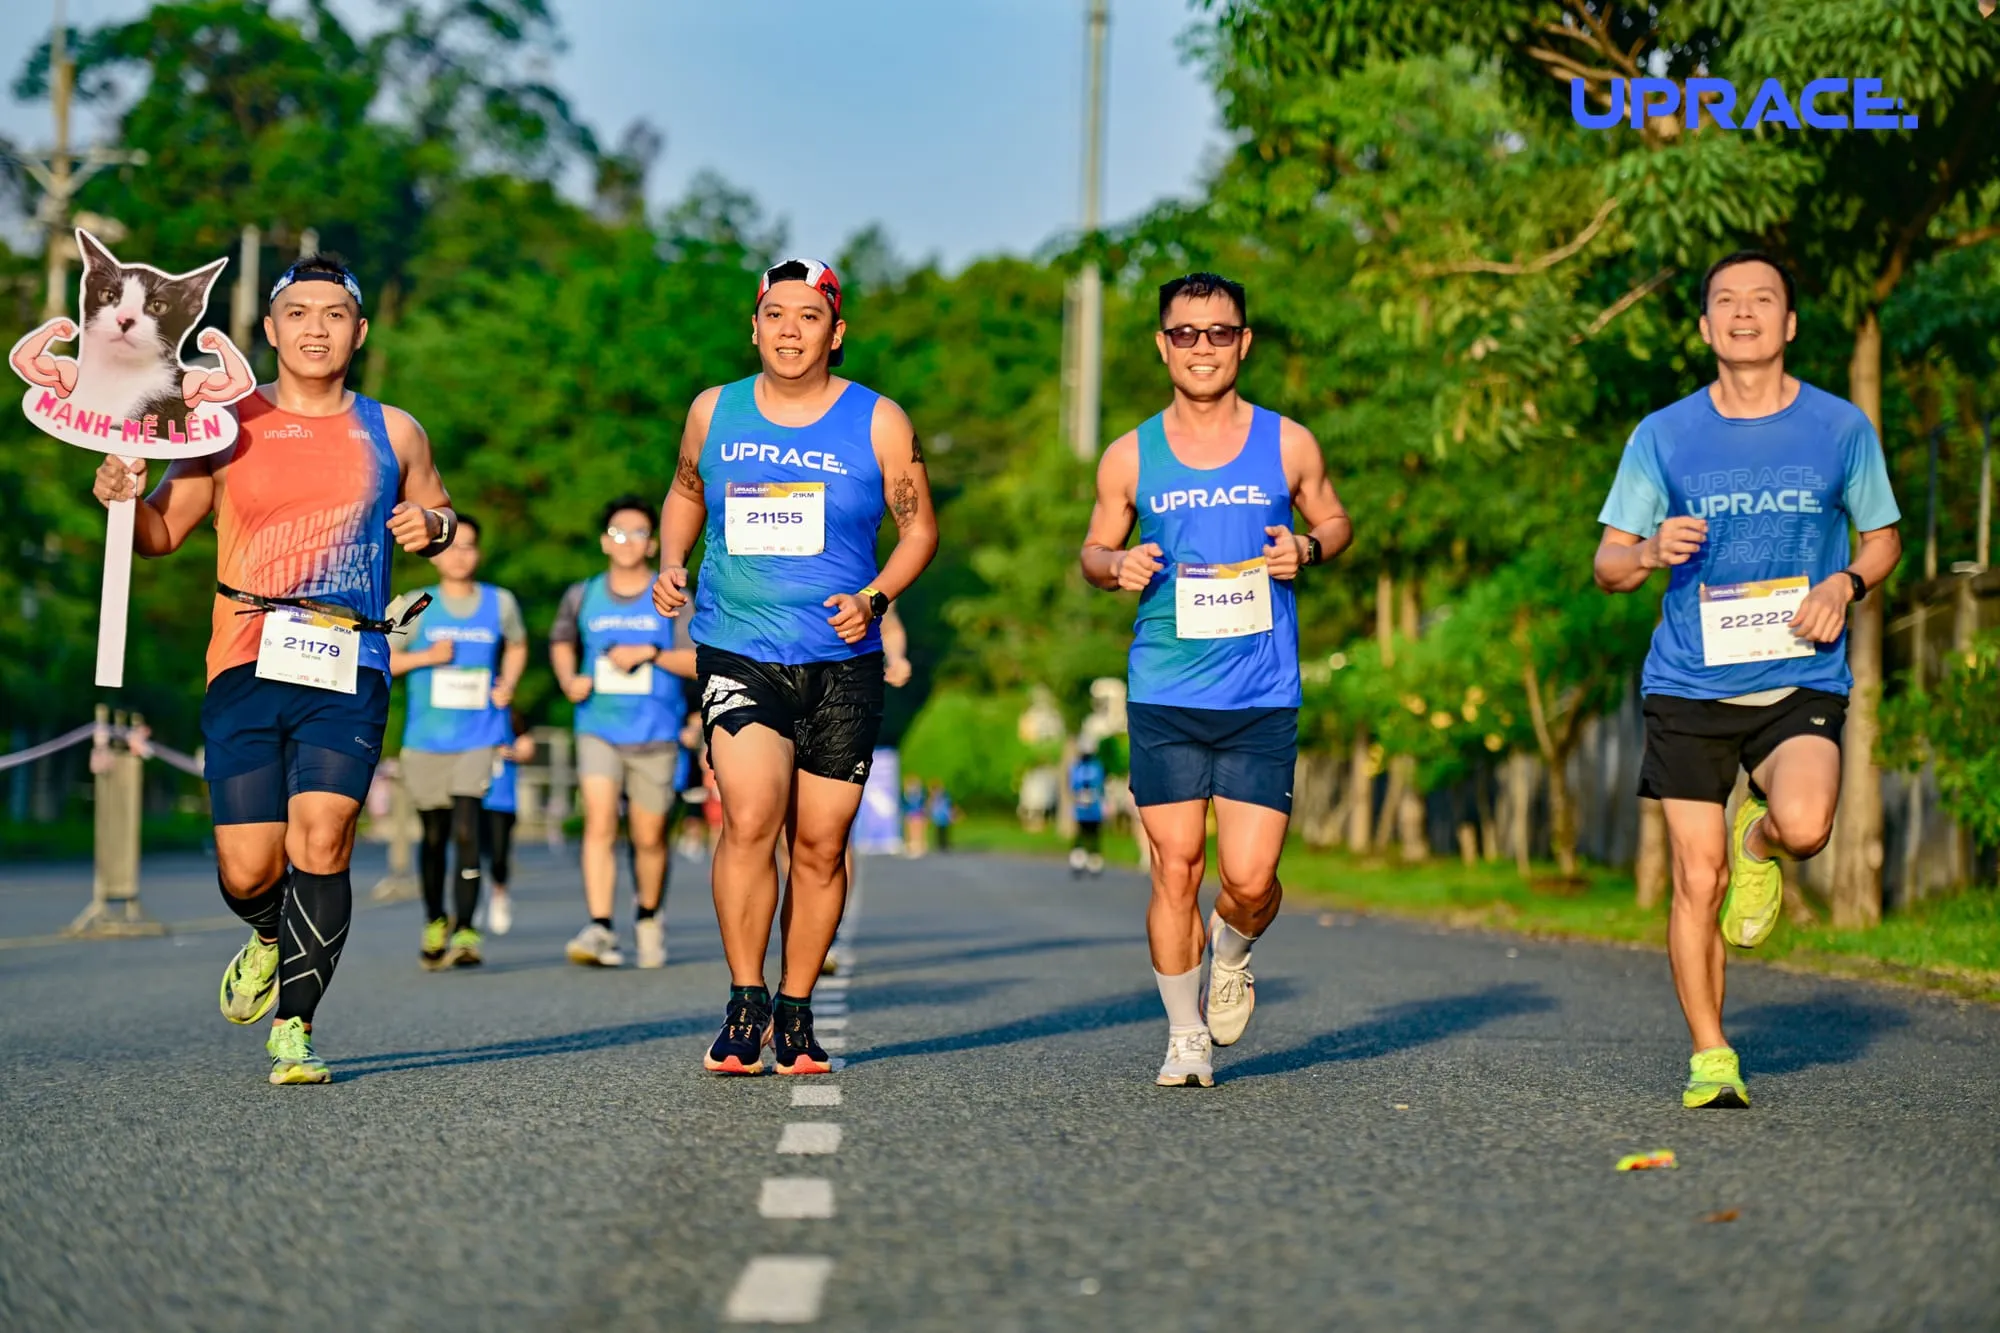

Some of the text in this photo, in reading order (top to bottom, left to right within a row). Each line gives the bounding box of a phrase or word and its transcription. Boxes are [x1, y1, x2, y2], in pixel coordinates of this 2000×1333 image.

[35, 391, 222, 444] MẠNH MẼ LÊN
[746, 511, 803, 524] 21155
[1194, 590, 1255, 606] 21464
[1720, 610, 1794, 630] 22222
[284, 637, 340, 657] 21179
